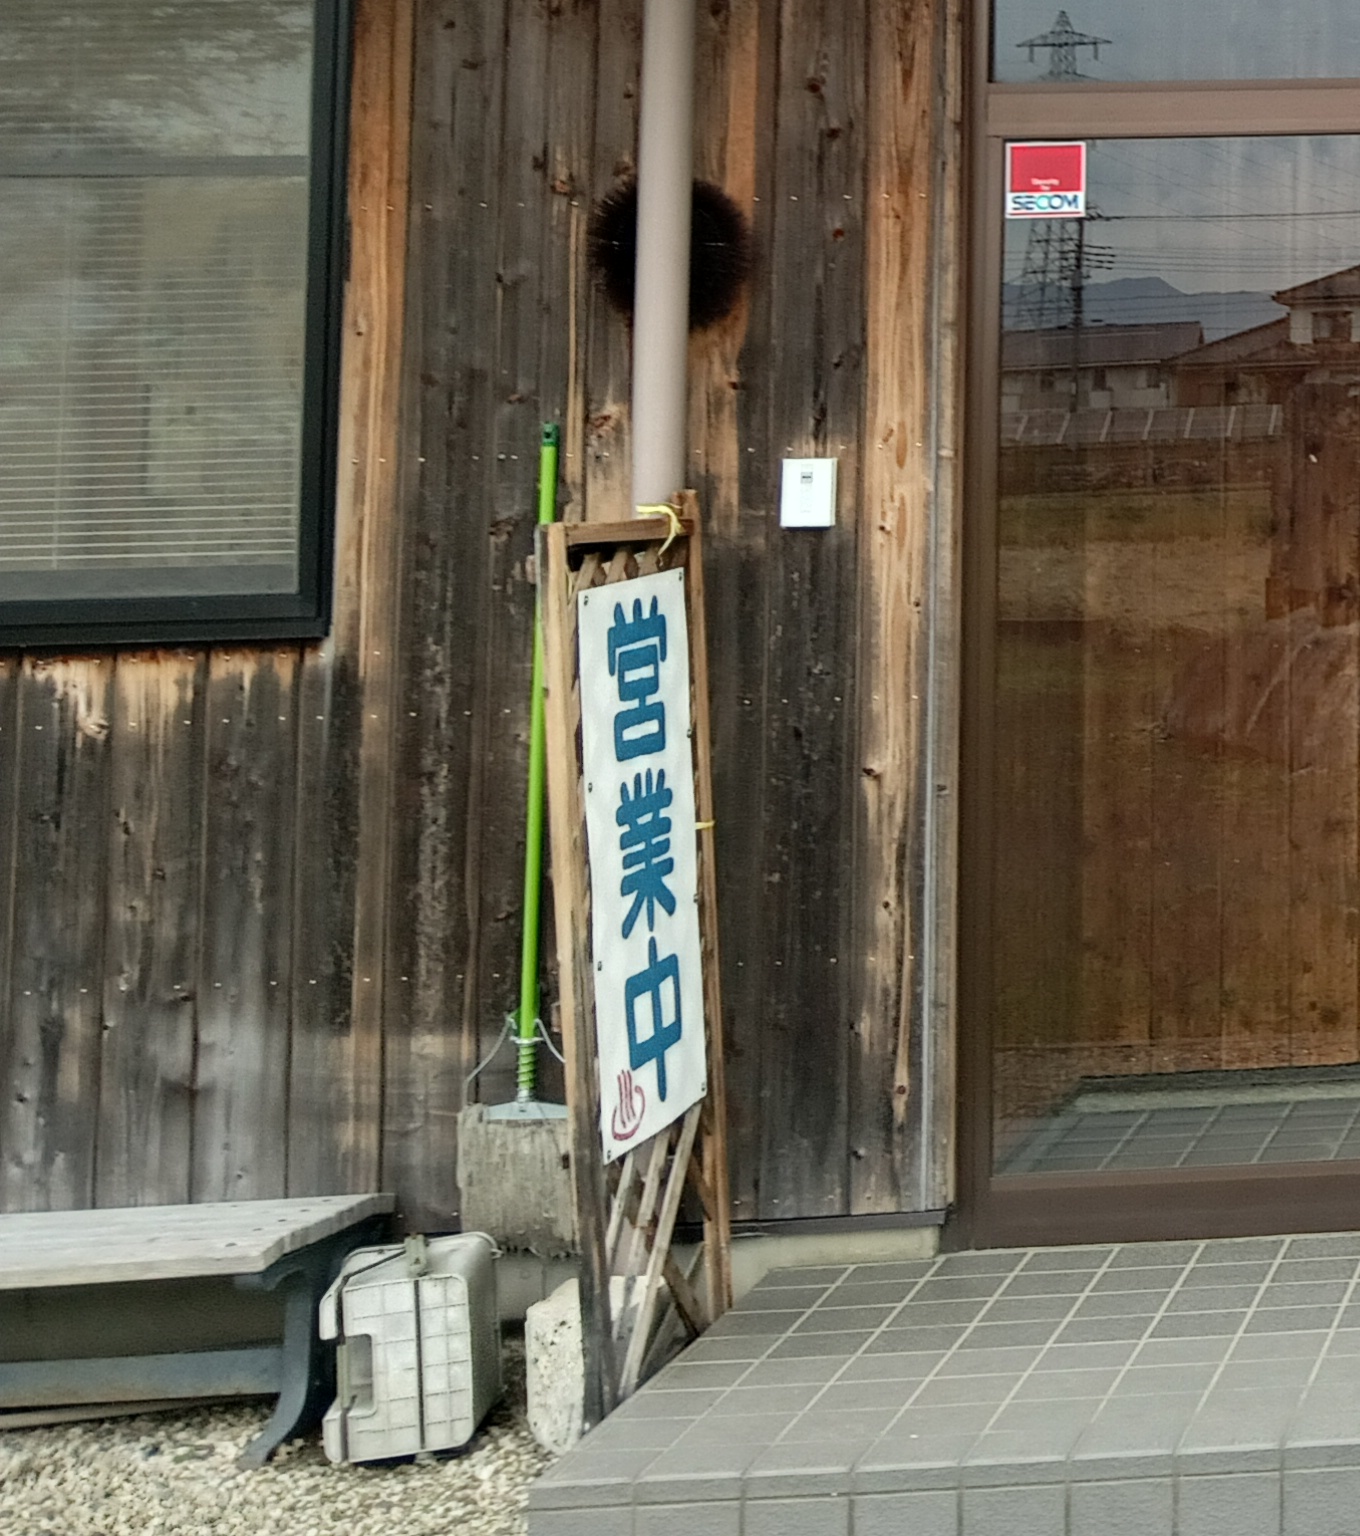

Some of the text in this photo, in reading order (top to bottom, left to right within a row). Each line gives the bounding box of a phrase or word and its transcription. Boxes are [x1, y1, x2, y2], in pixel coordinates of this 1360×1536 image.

[1011, 195, 1079, 210] SECOM
[606, 594, 683, 1102] 営業中
